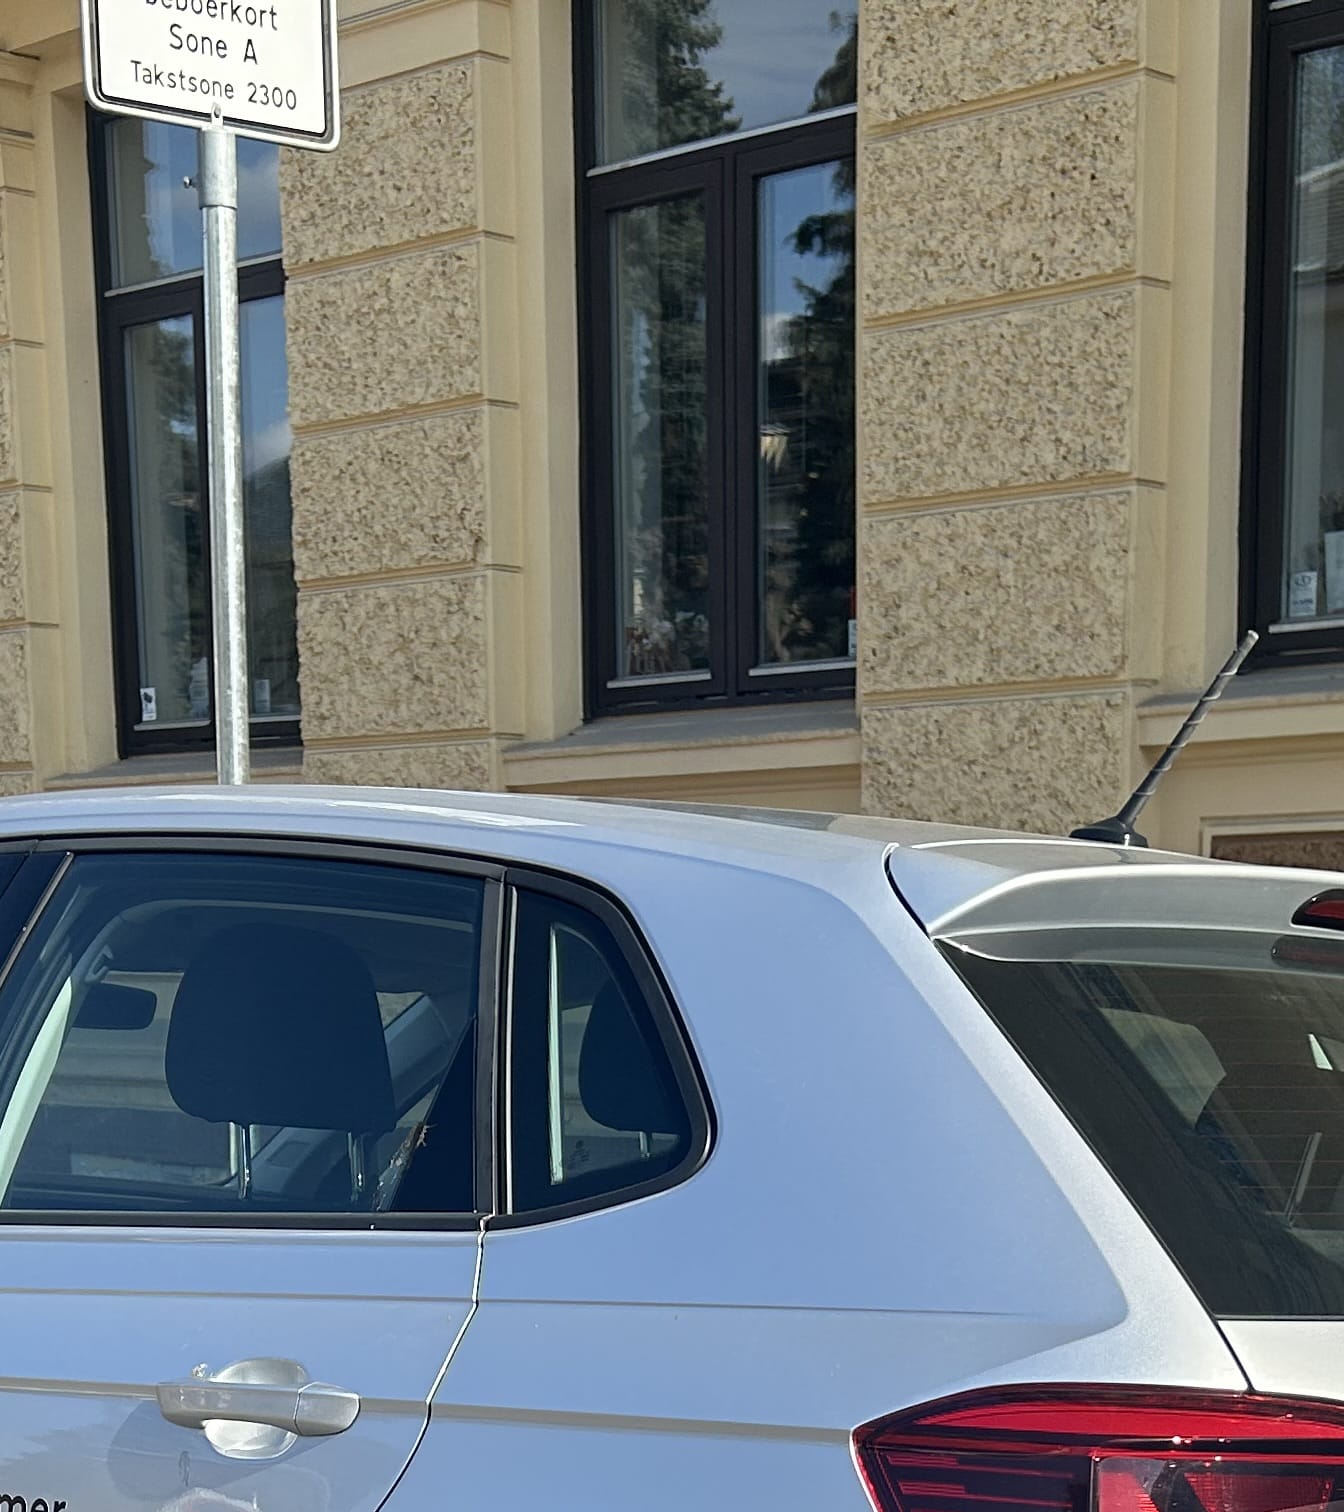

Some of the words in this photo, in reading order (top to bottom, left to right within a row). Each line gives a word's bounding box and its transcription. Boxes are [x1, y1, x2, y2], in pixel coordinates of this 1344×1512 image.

[146, 0, 278, 31] oerkort
[169, 23, 228, 59] Sone
[243, 38, 258, 65] A
[130, 60, 235, 99] Takstsone
[247, 82, 297, 110] 2300
